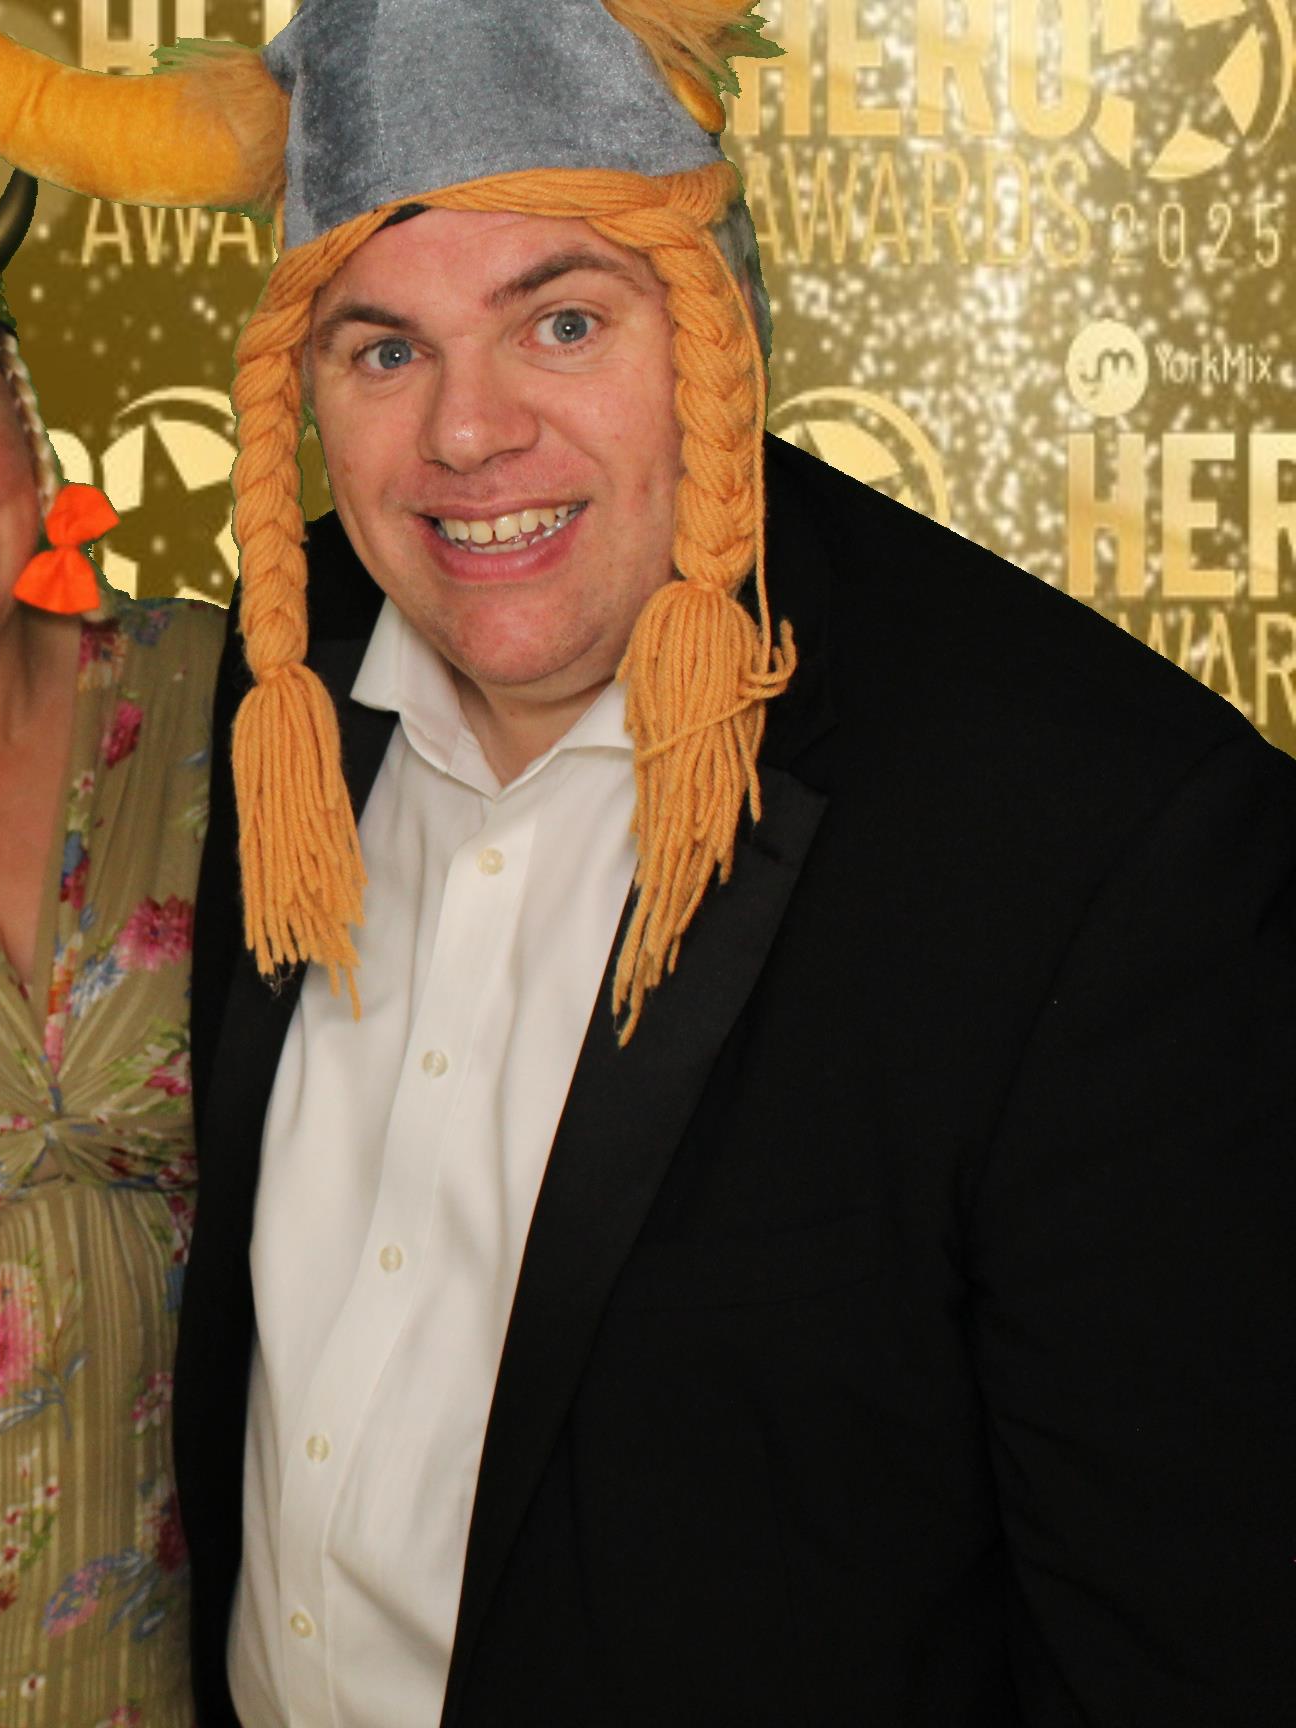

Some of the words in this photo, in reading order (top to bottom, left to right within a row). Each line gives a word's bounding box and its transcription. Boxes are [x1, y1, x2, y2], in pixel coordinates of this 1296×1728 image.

[733, 0, 1091, 139] HERO
[745, 151, 1094, 268] AWARDS
[1111, 202, 1281, 269] 2025
[1155, 343, 1273, 384] YorkMix
[1067, 432, 1296, 598] HER
